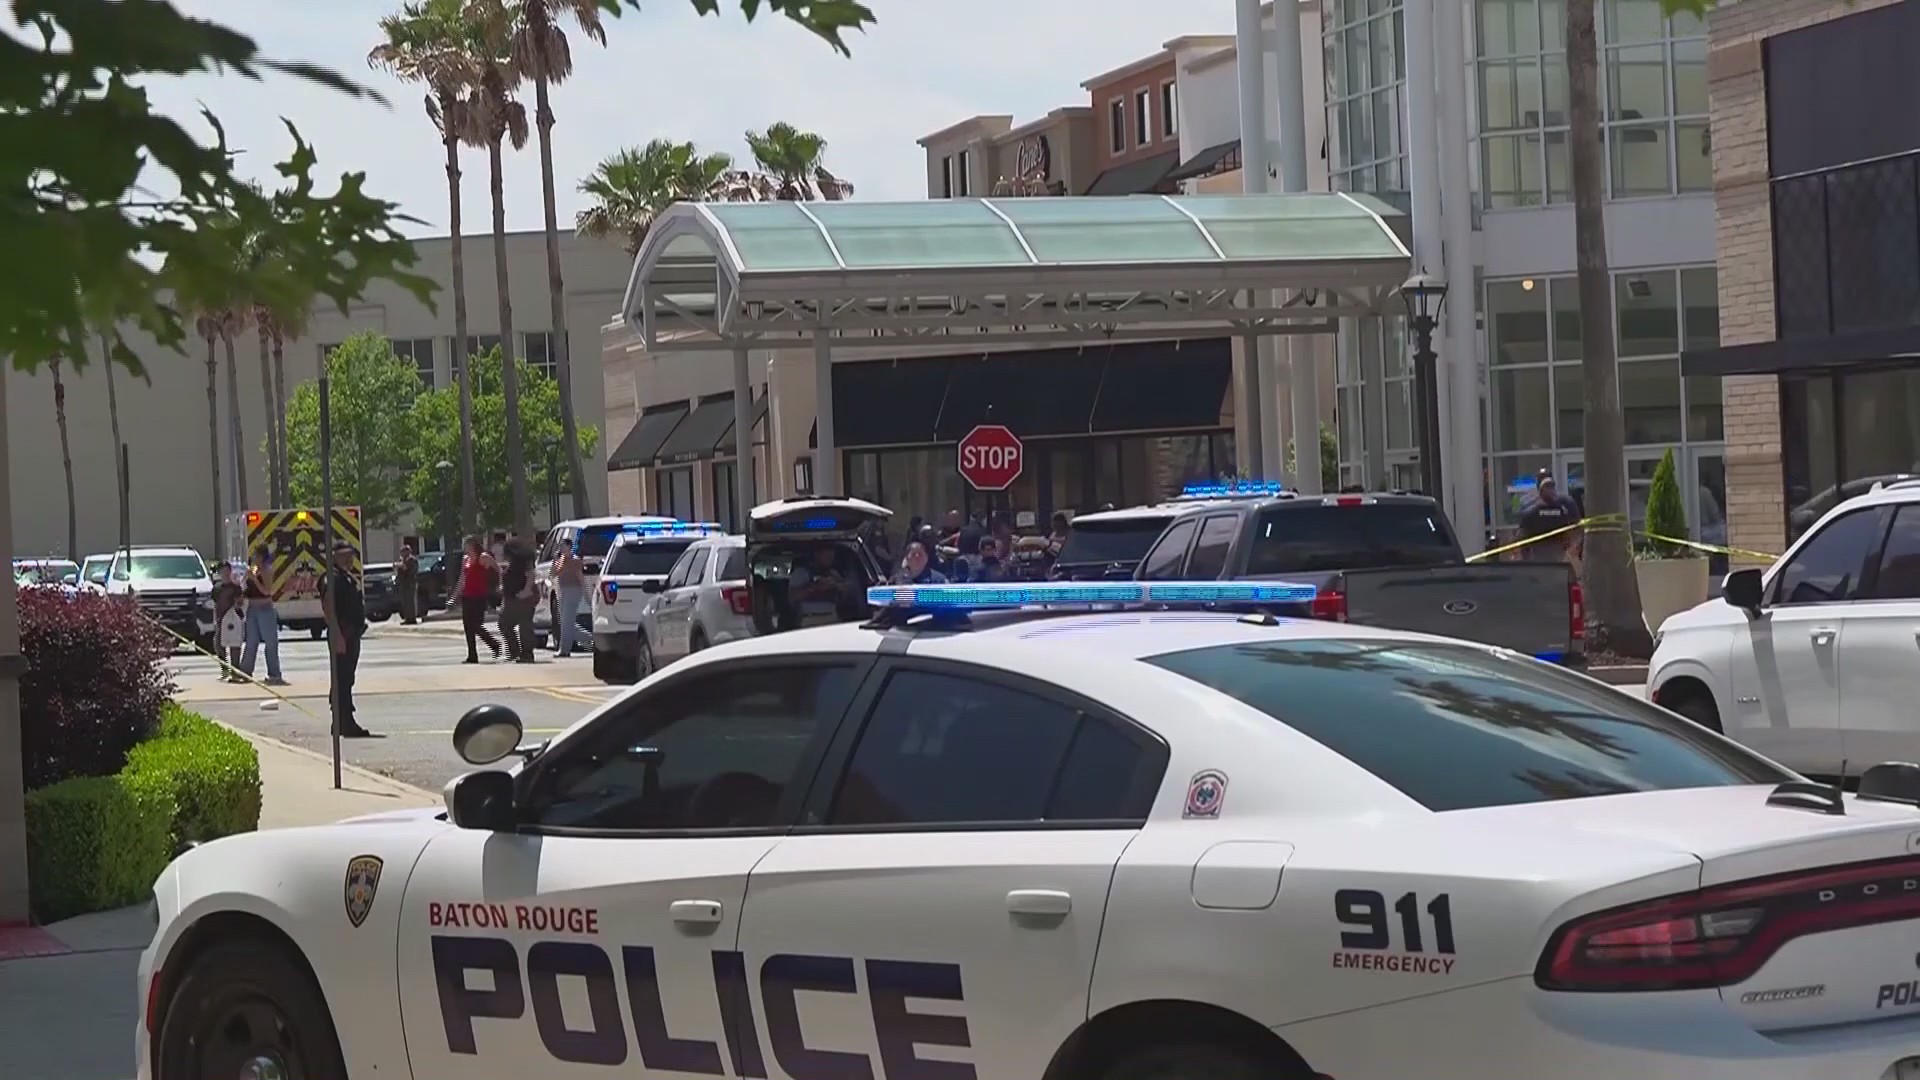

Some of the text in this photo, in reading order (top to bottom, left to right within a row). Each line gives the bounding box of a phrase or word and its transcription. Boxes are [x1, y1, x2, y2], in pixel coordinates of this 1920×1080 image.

[963, 445, 1018, 469] STOP
[429, 903, 599, 934] BATON ROUGE
[1335, 889, 1456, 954] 911
[1333, 952, 1455, 974] EMERGENCY
[431, 935, 979, 1080] POLICE
